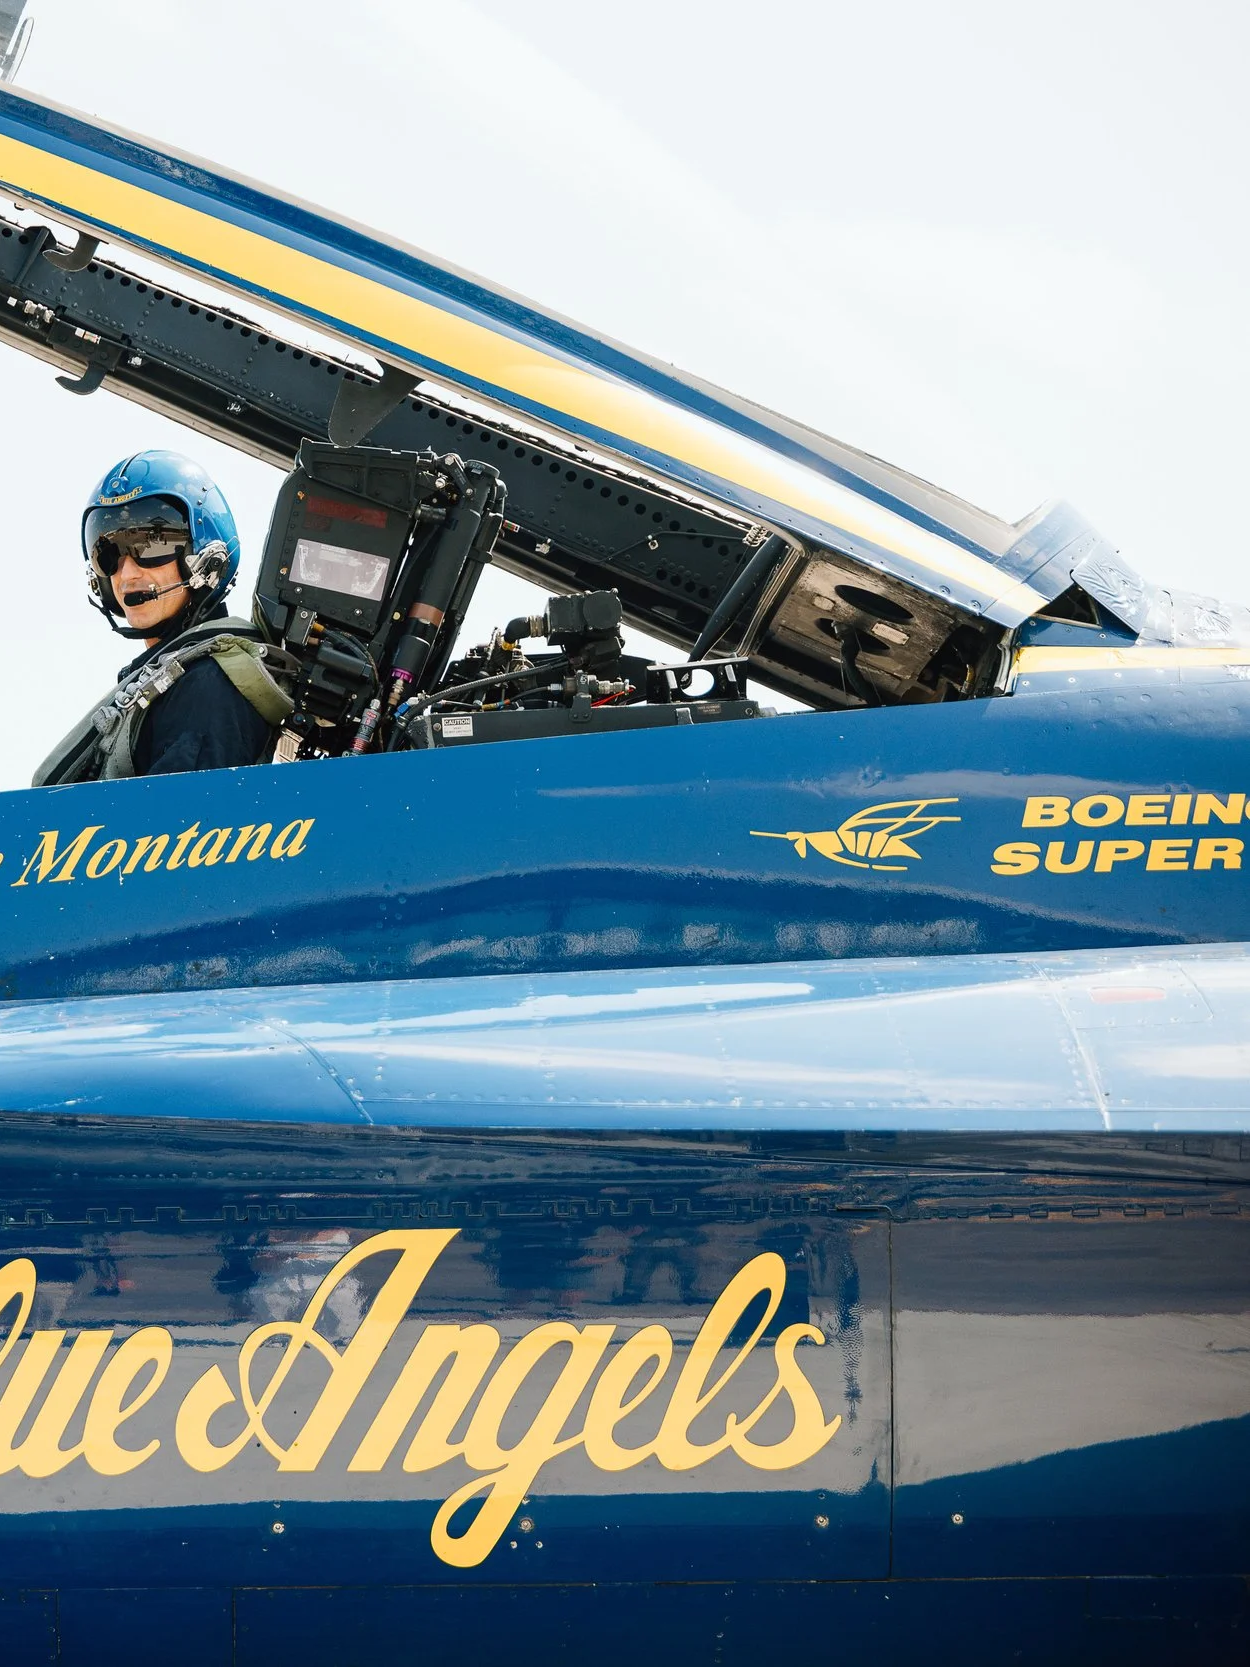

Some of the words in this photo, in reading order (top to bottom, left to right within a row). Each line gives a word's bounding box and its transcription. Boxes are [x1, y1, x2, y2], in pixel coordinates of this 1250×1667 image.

[1022, 793, 1250, 828] BOEIN
[11, 817, 316, 887] Montana
[991, 838, 1245, 875] SUPER
[175, 1228, 843, 1568] Angels
